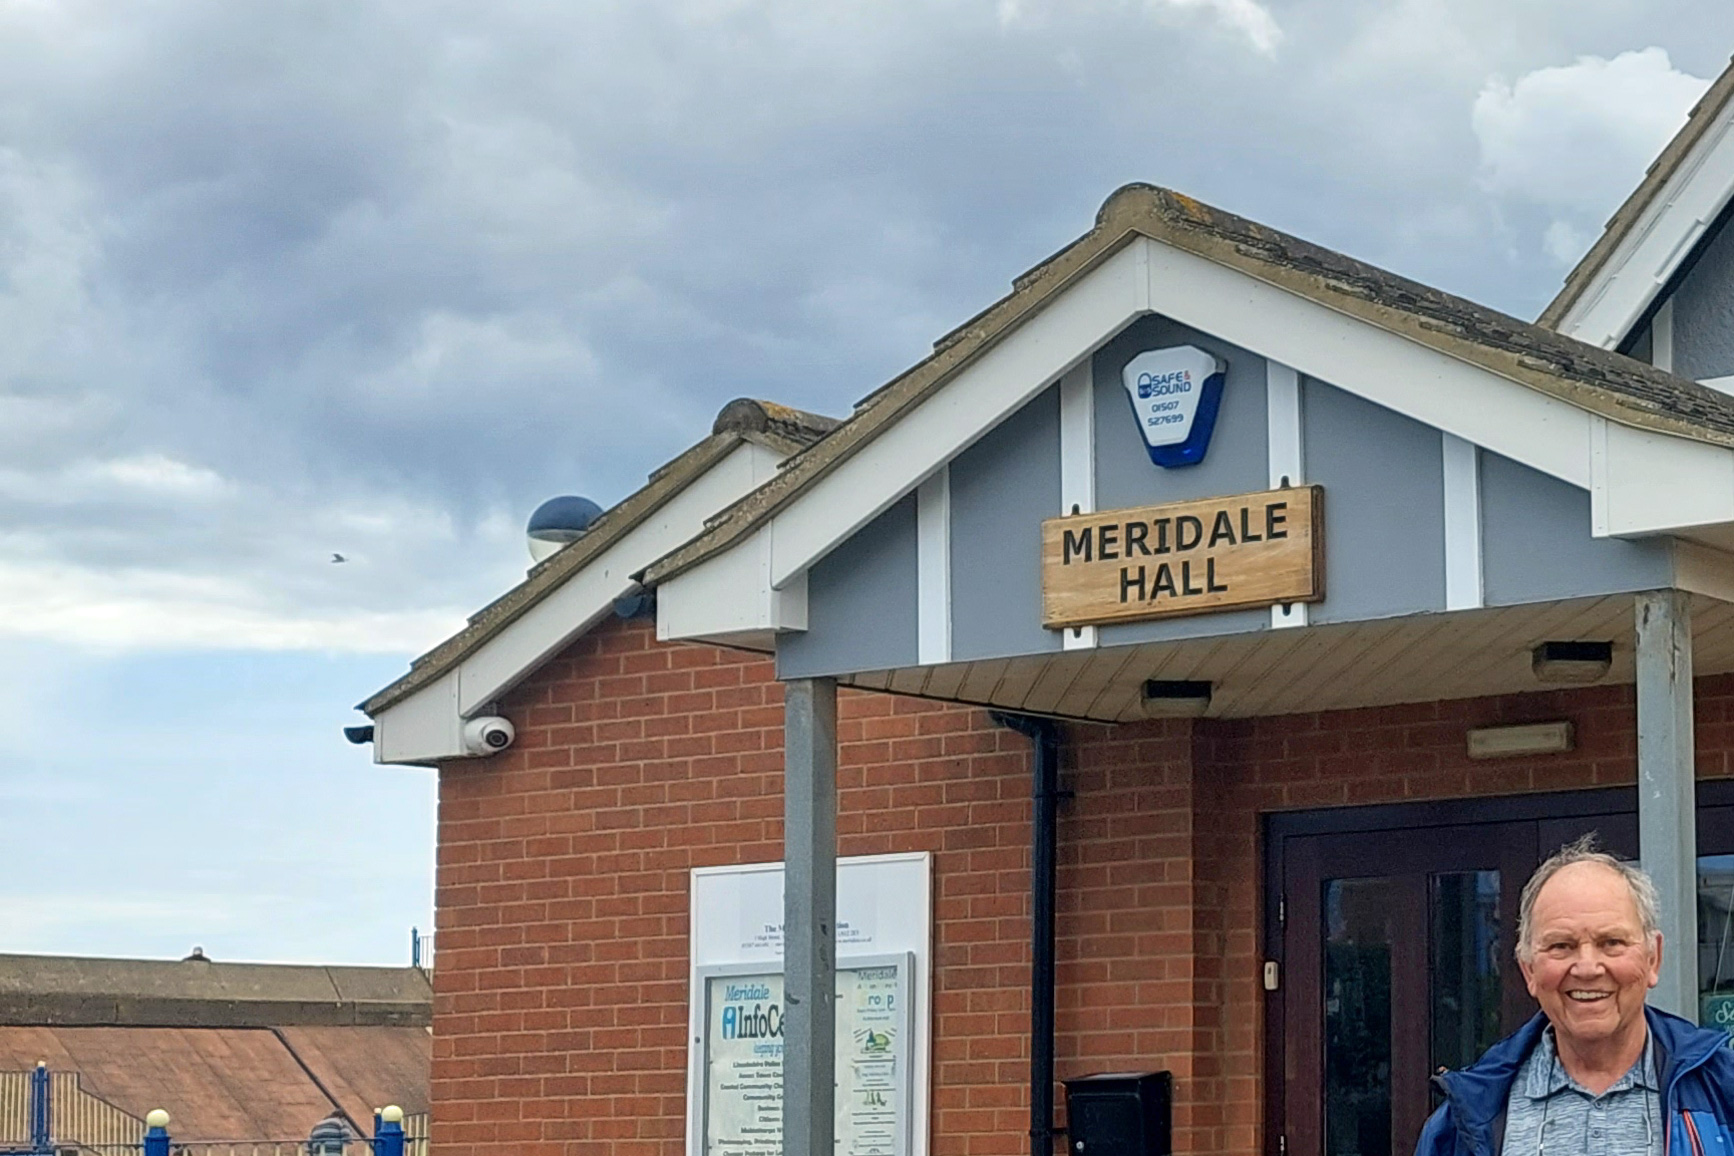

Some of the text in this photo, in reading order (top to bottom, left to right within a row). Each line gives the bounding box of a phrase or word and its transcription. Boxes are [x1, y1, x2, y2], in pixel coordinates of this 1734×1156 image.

[1152, 370, 1191, 386] SAFE &
[1152, 381, 1192, 397] SOUND
[1151, 401, 1179, 413] 01507
[1147, 413, 1184, 427] 527699
[1063, 502, 1287, 565] MERIDALE
[1120, 557, 1228, 603] HALL
[764, 924, 776, 933] The
[725, 984, 770, 1001] Meridale
[737, 1003, 784, 1039] InfoCe
